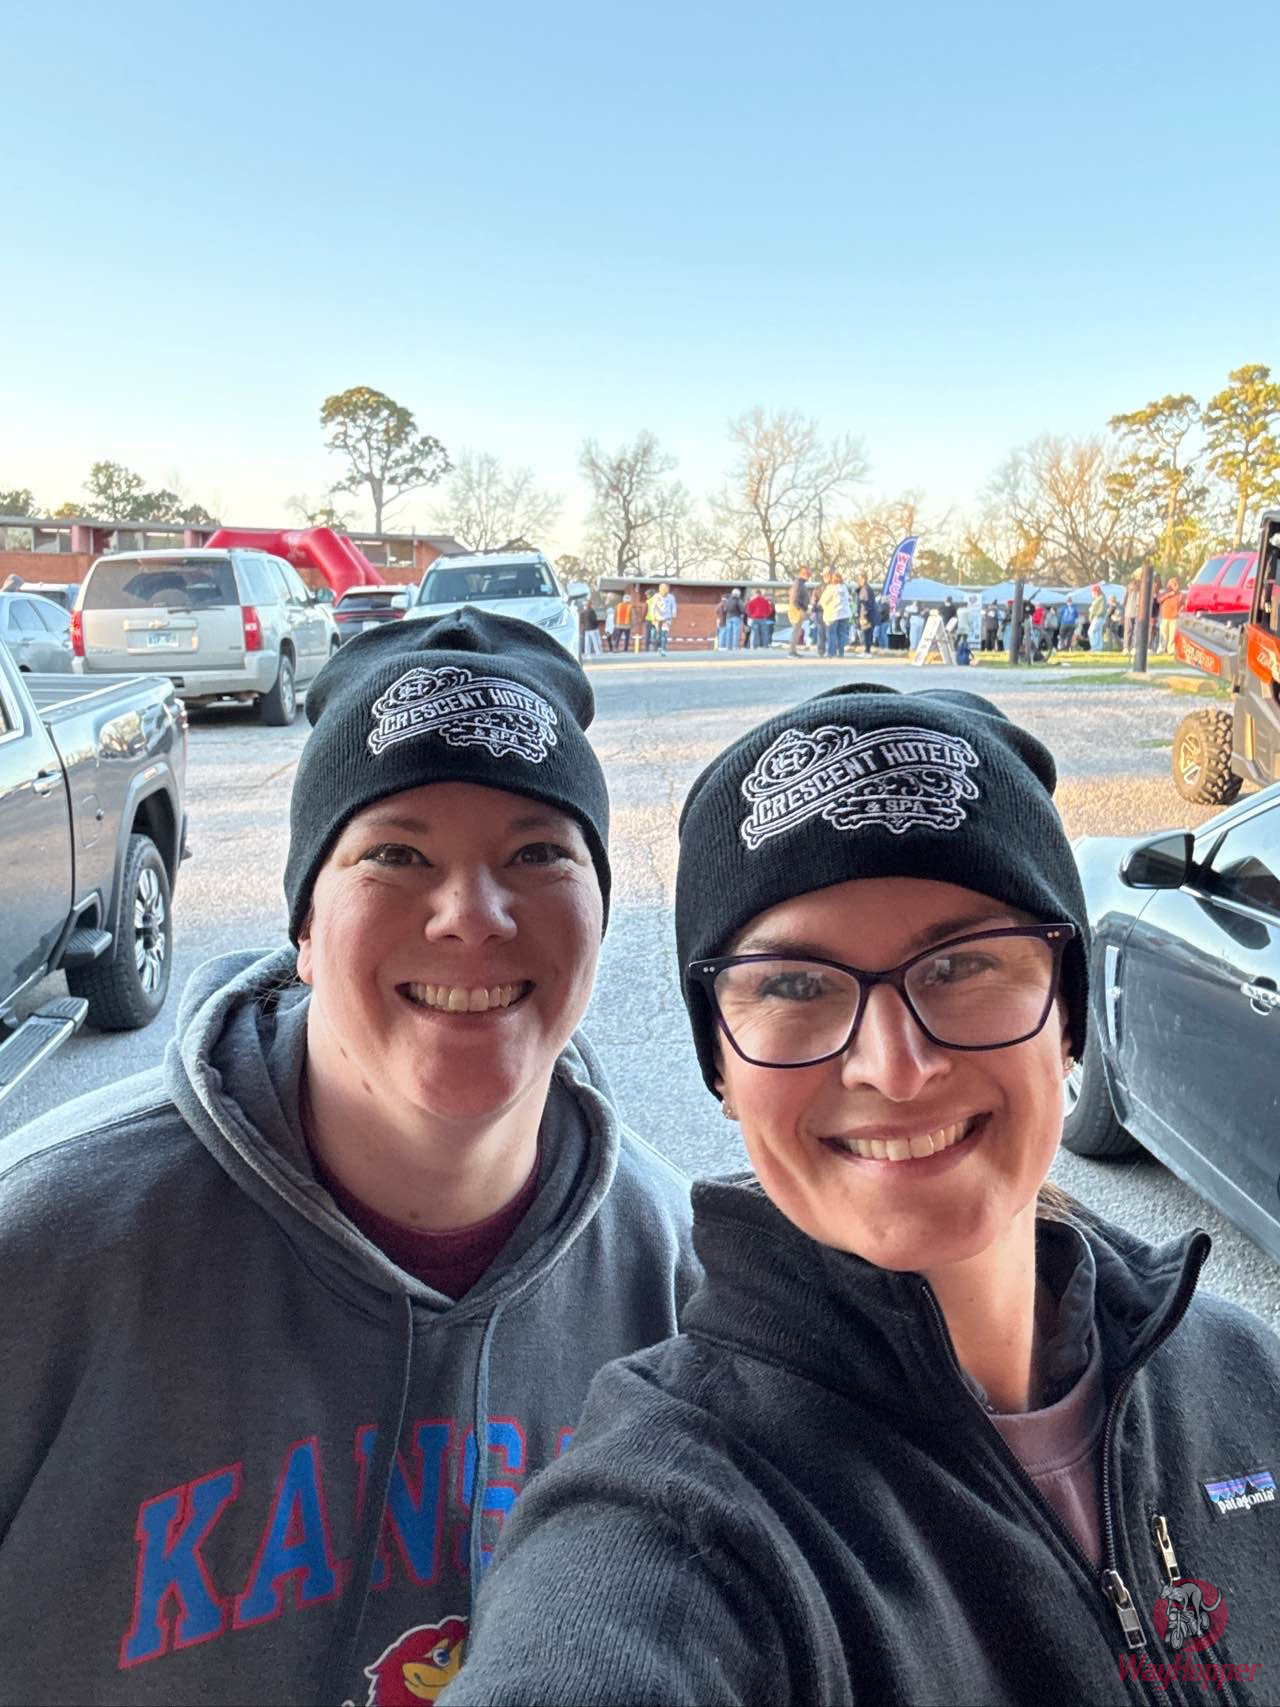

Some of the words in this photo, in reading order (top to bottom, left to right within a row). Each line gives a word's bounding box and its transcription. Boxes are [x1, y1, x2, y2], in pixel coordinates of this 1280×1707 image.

[385, 690, 487, 733] CRESCENT
[489, 687, 546, 718] HOTEL
[473, 727, 486, 737] &
[489, 728, 520, 744] SPA
[758, 750, 875, 823] CRESCENT
[881, 742, 957, 767] HOTEL
[865, 801, 879, 813] &
[885, 799, 927, 814] SPA
[1217, 1487, 1275, 1514] patagonia
[118, 1415, 574, 1671] KANS
